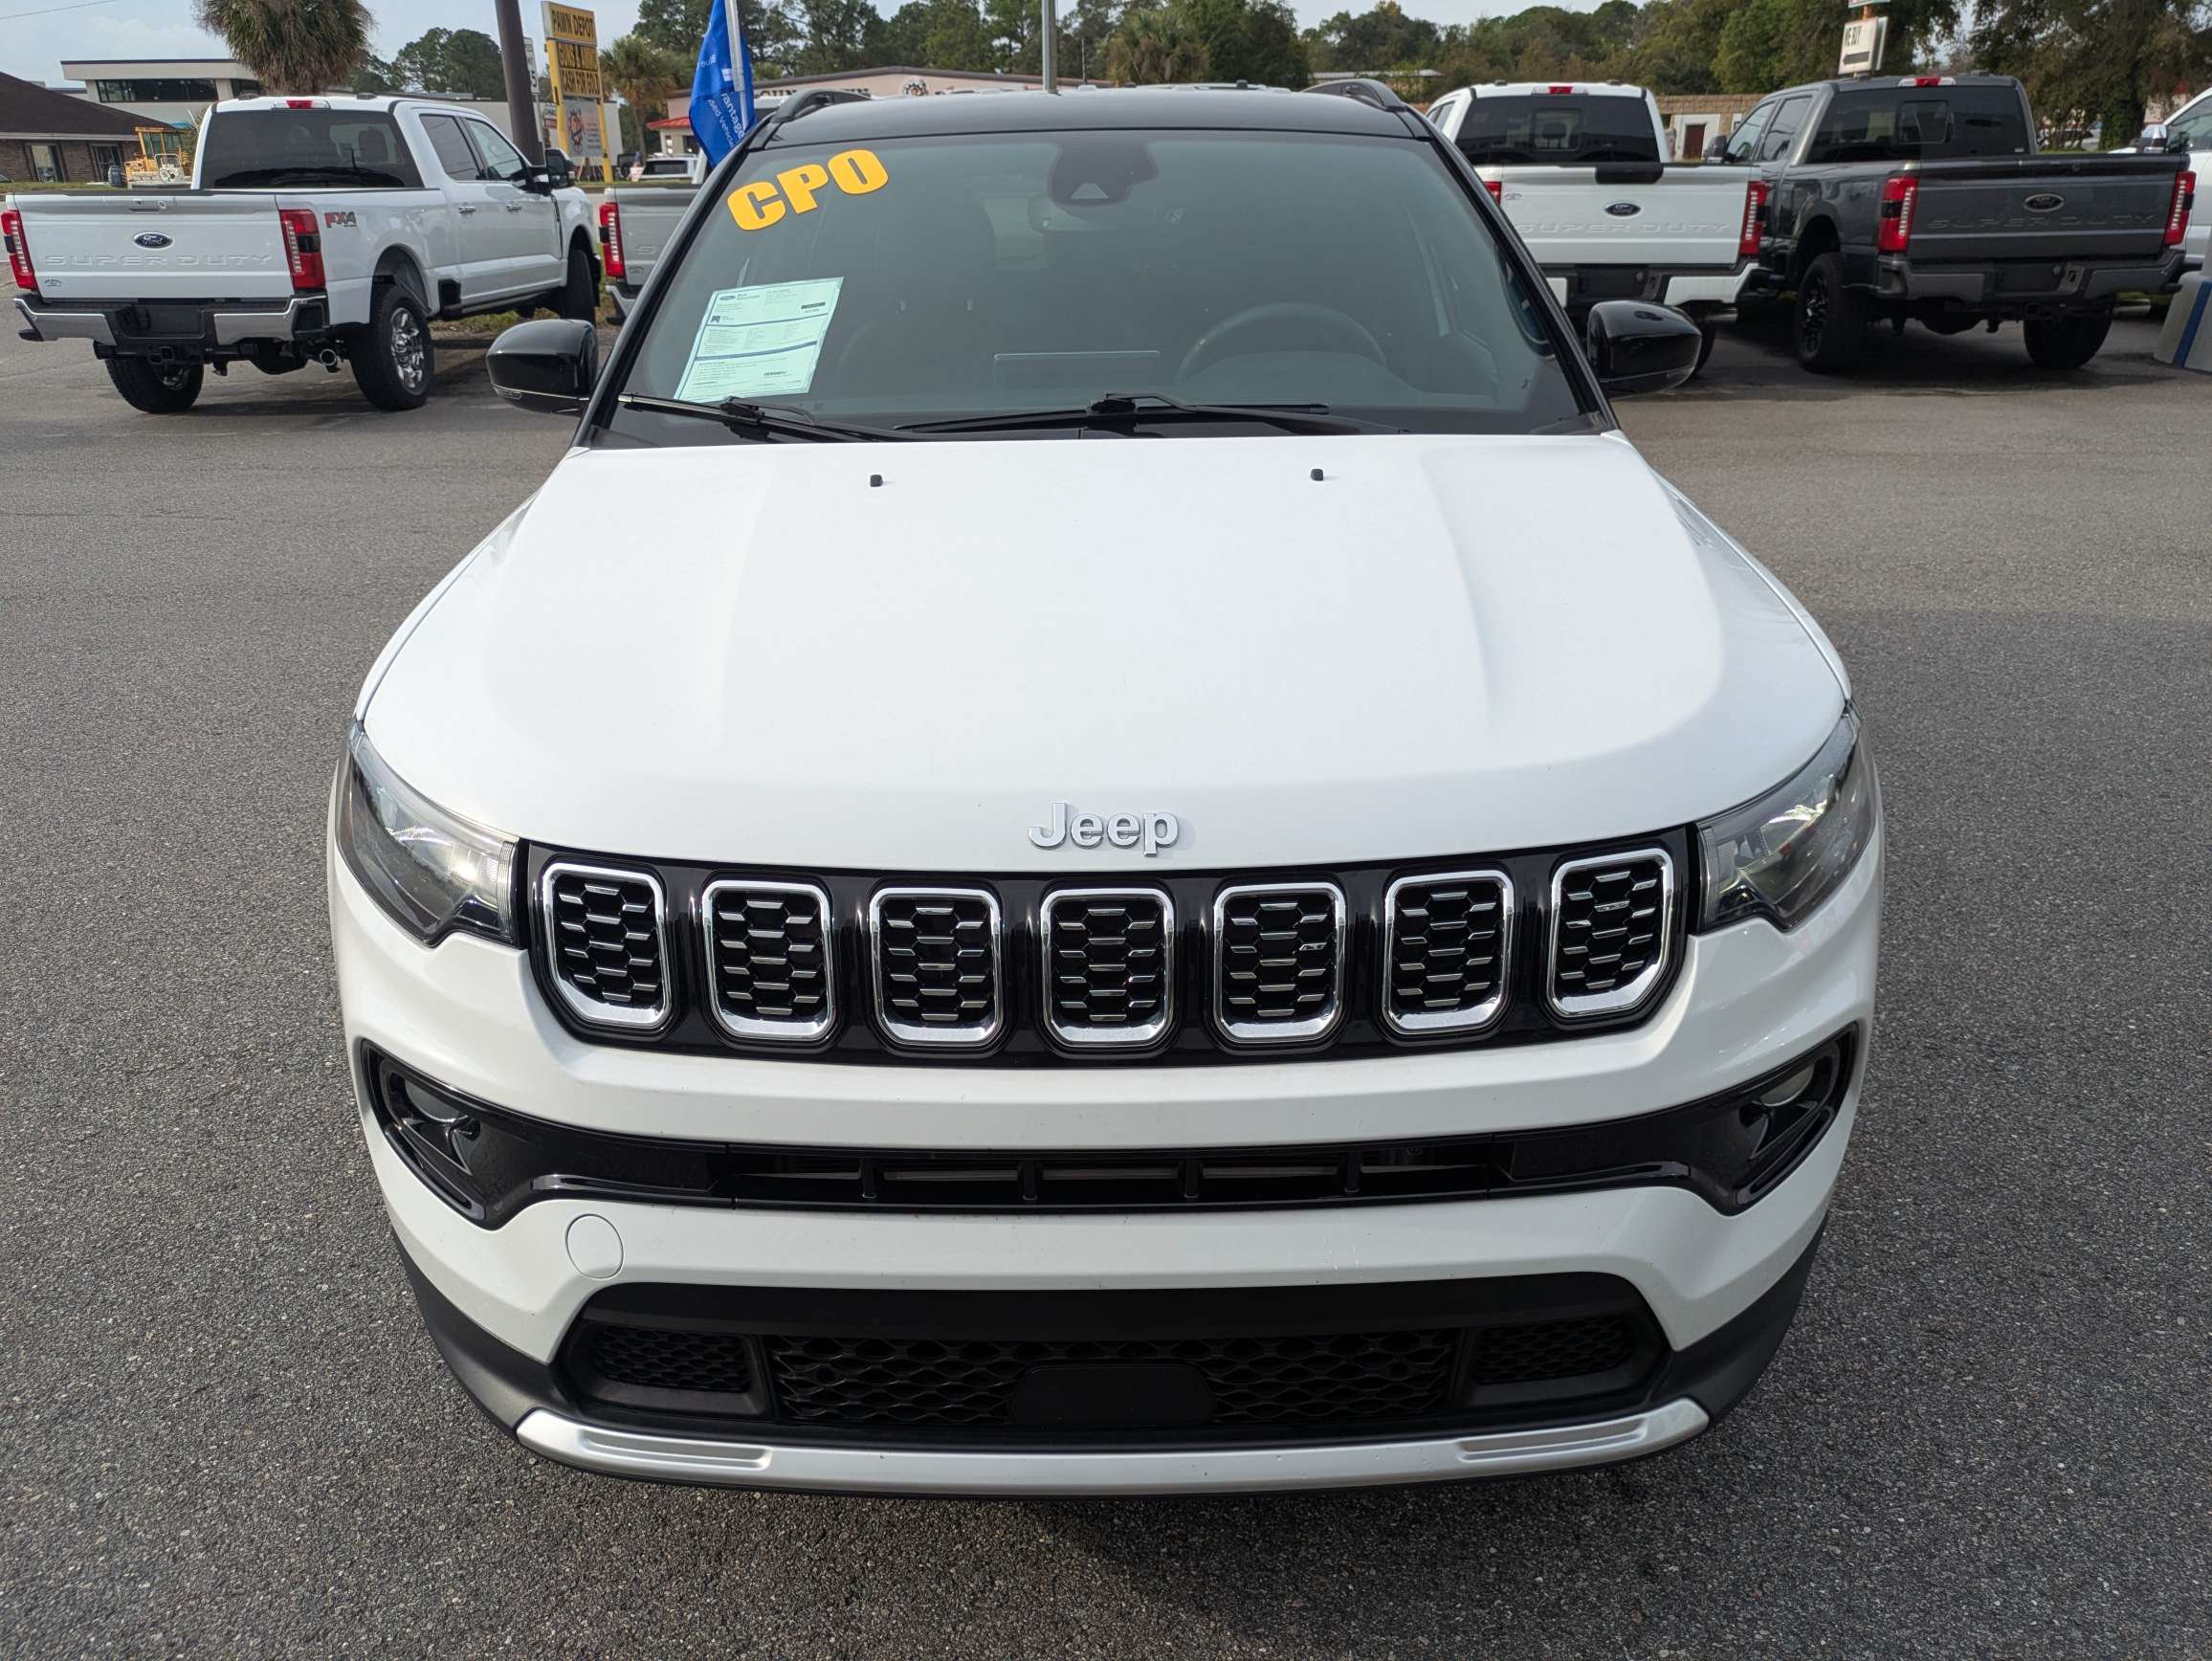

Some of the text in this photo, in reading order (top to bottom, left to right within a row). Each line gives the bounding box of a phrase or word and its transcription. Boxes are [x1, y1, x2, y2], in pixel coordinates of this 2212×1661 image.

[552, 10, 594, 38] PAWN DEPOT
[530, 70, 537, 87] 5
[727, 148, 889, 231] CPO
[324, 211, 356, 229] FX4
[1515, 222, 1730, 233] SUPER DUTY
[1927, 214, 2155, 229] SUPER DUTY
[45, 255, 274, 266] SUPER DUTY
[1029, 802, 1180, 857] Jeep
